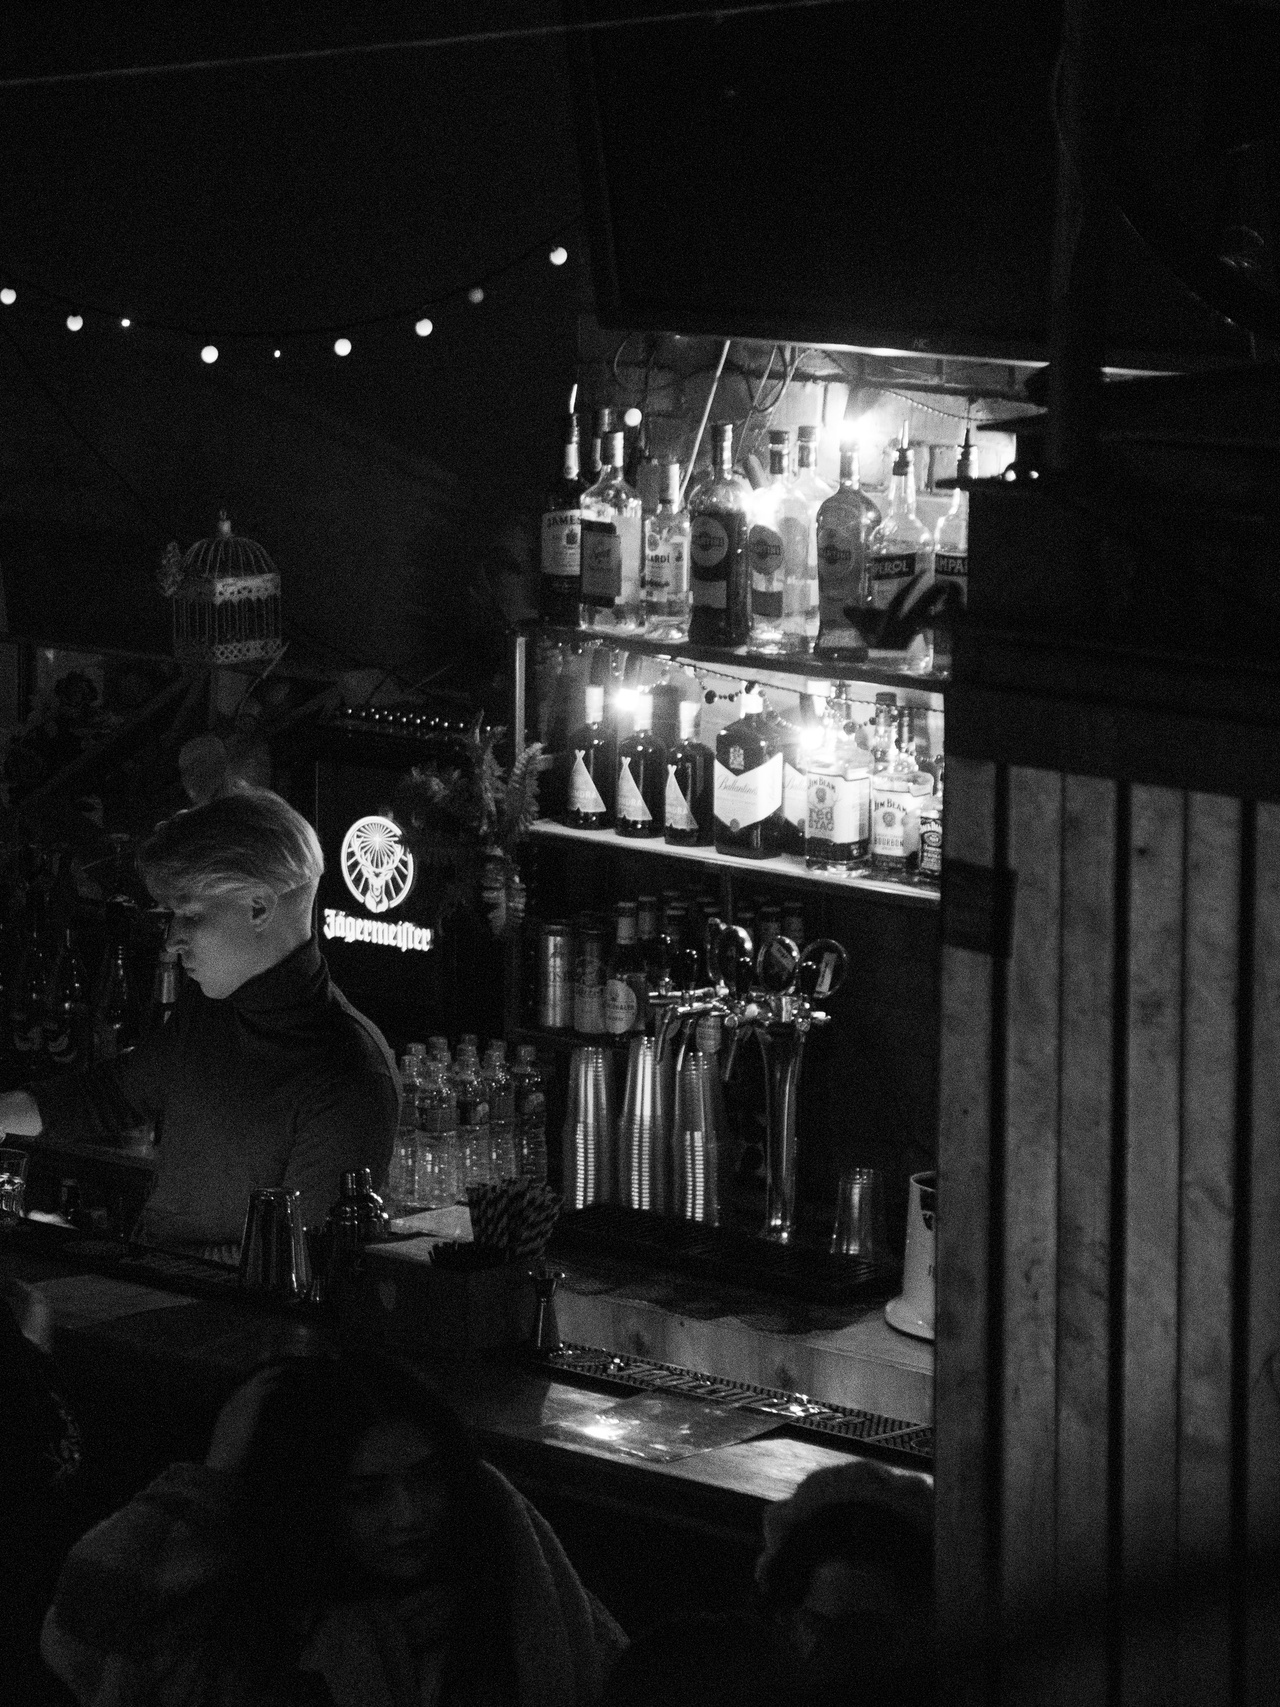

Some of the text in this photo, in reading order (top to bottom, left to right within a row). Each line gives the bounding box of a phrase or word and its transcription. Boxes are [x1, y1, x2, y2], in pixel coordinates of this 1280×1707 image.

[874, 798, 908, 816] JIM BEAM
[323, 907, 433, 952] Jägermeister
